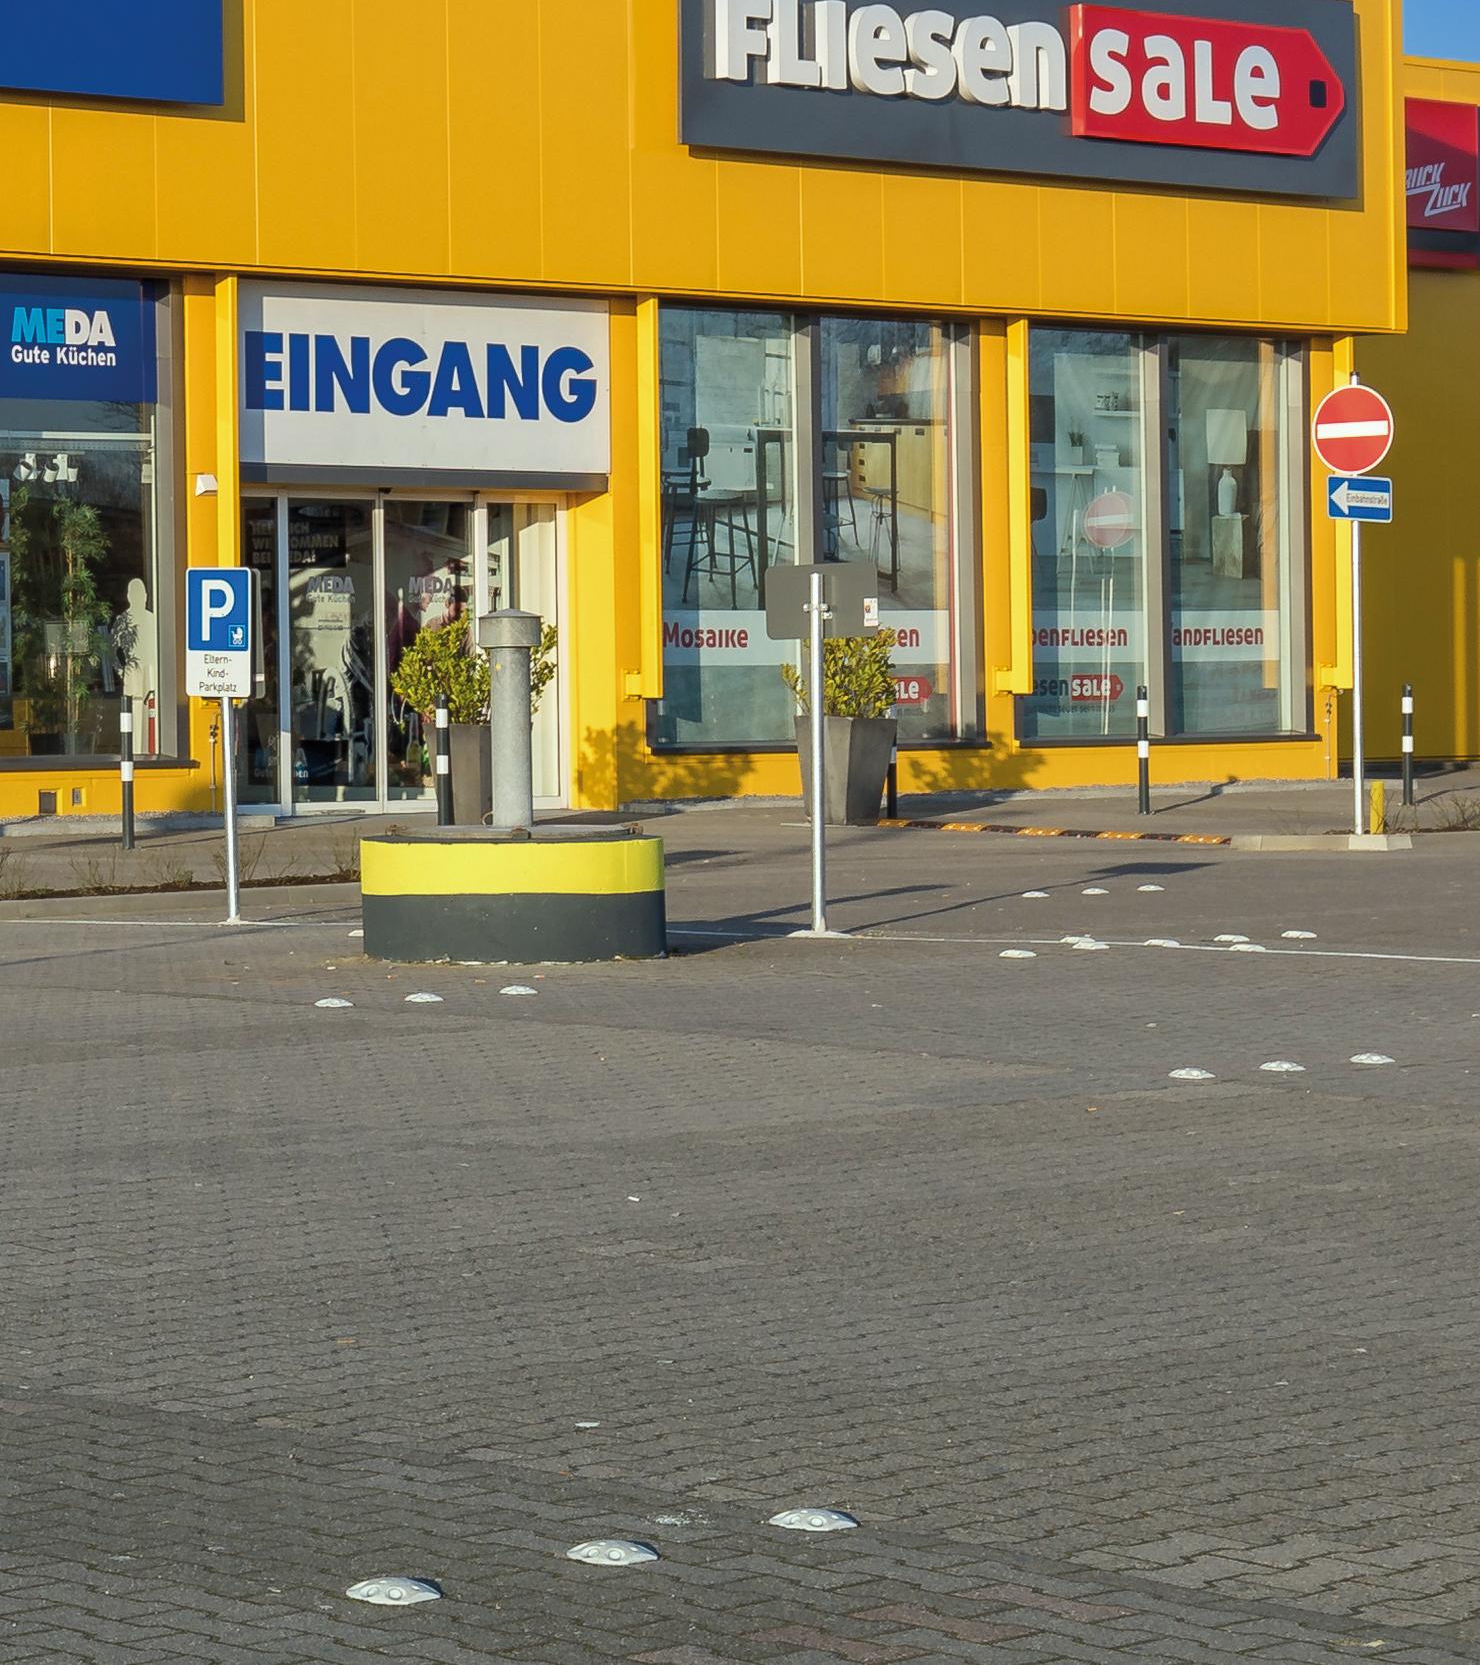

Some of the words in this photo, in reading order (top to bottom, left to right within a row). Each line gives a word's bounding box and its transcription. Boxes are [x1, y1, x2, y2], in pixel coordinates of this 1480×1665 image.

[10, 306, 116, 348] MEDA
[11, 344, 50, 365] Gute
[56, 346, 117, 367] Küchen
[244, 330, 598, 423] EINGANG
[307, 575, 355, 593] MEDA
[201, 579, 235, 641] P
[203, 653, 233, 665] Eltern-
[207, 667, 229, 679] Kind-
[198, 680, 238, 695] Parkplatz
